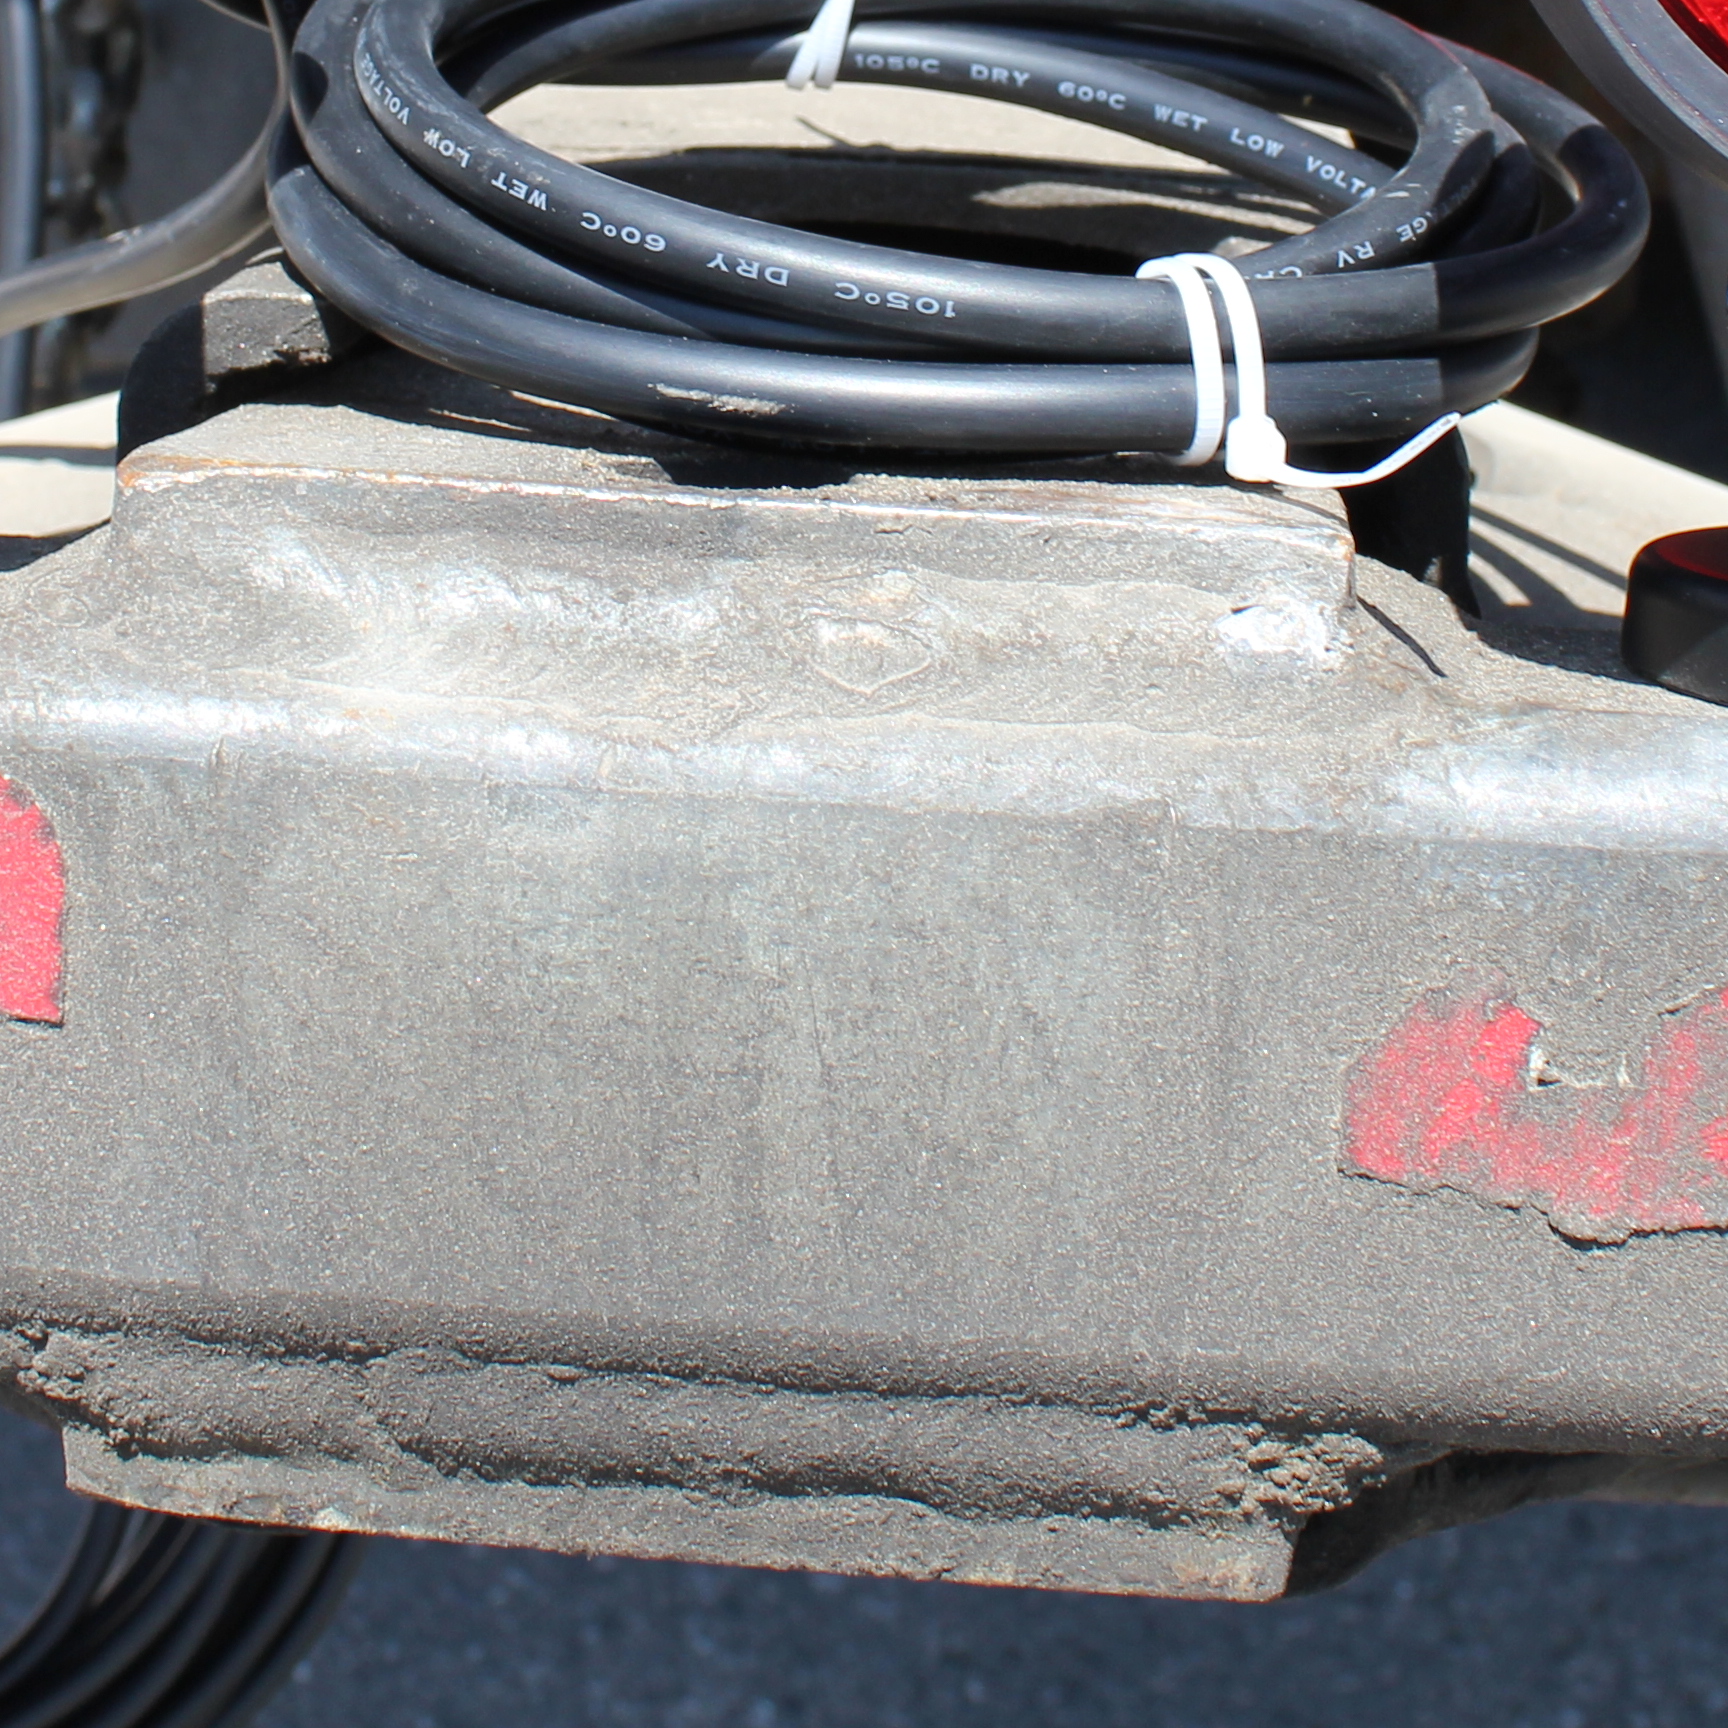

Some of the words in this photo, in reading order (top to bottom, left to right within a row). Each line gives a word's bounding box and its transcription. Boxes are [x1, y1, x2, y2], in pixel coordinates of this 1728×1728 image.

[362, 52, 411, 126] VOLTAGE
[854, 52, 941, 75] 105°C
[969, 63, 1031, 88] DRY
[1057, 80, 1127, 111] 60°C
[1153, 102, 1209, 133] WET
[1229, 127, 1286, 159] LOW
[423, 128, 472, 169] LOW
[491, 171, 548, 212] WET
[579, 210, 667, 254] 60°C
[706, 252, 791, 288] DRY
[1336, 240, 1376, 269] RV
[834, 281, 957, 319] 105°C
